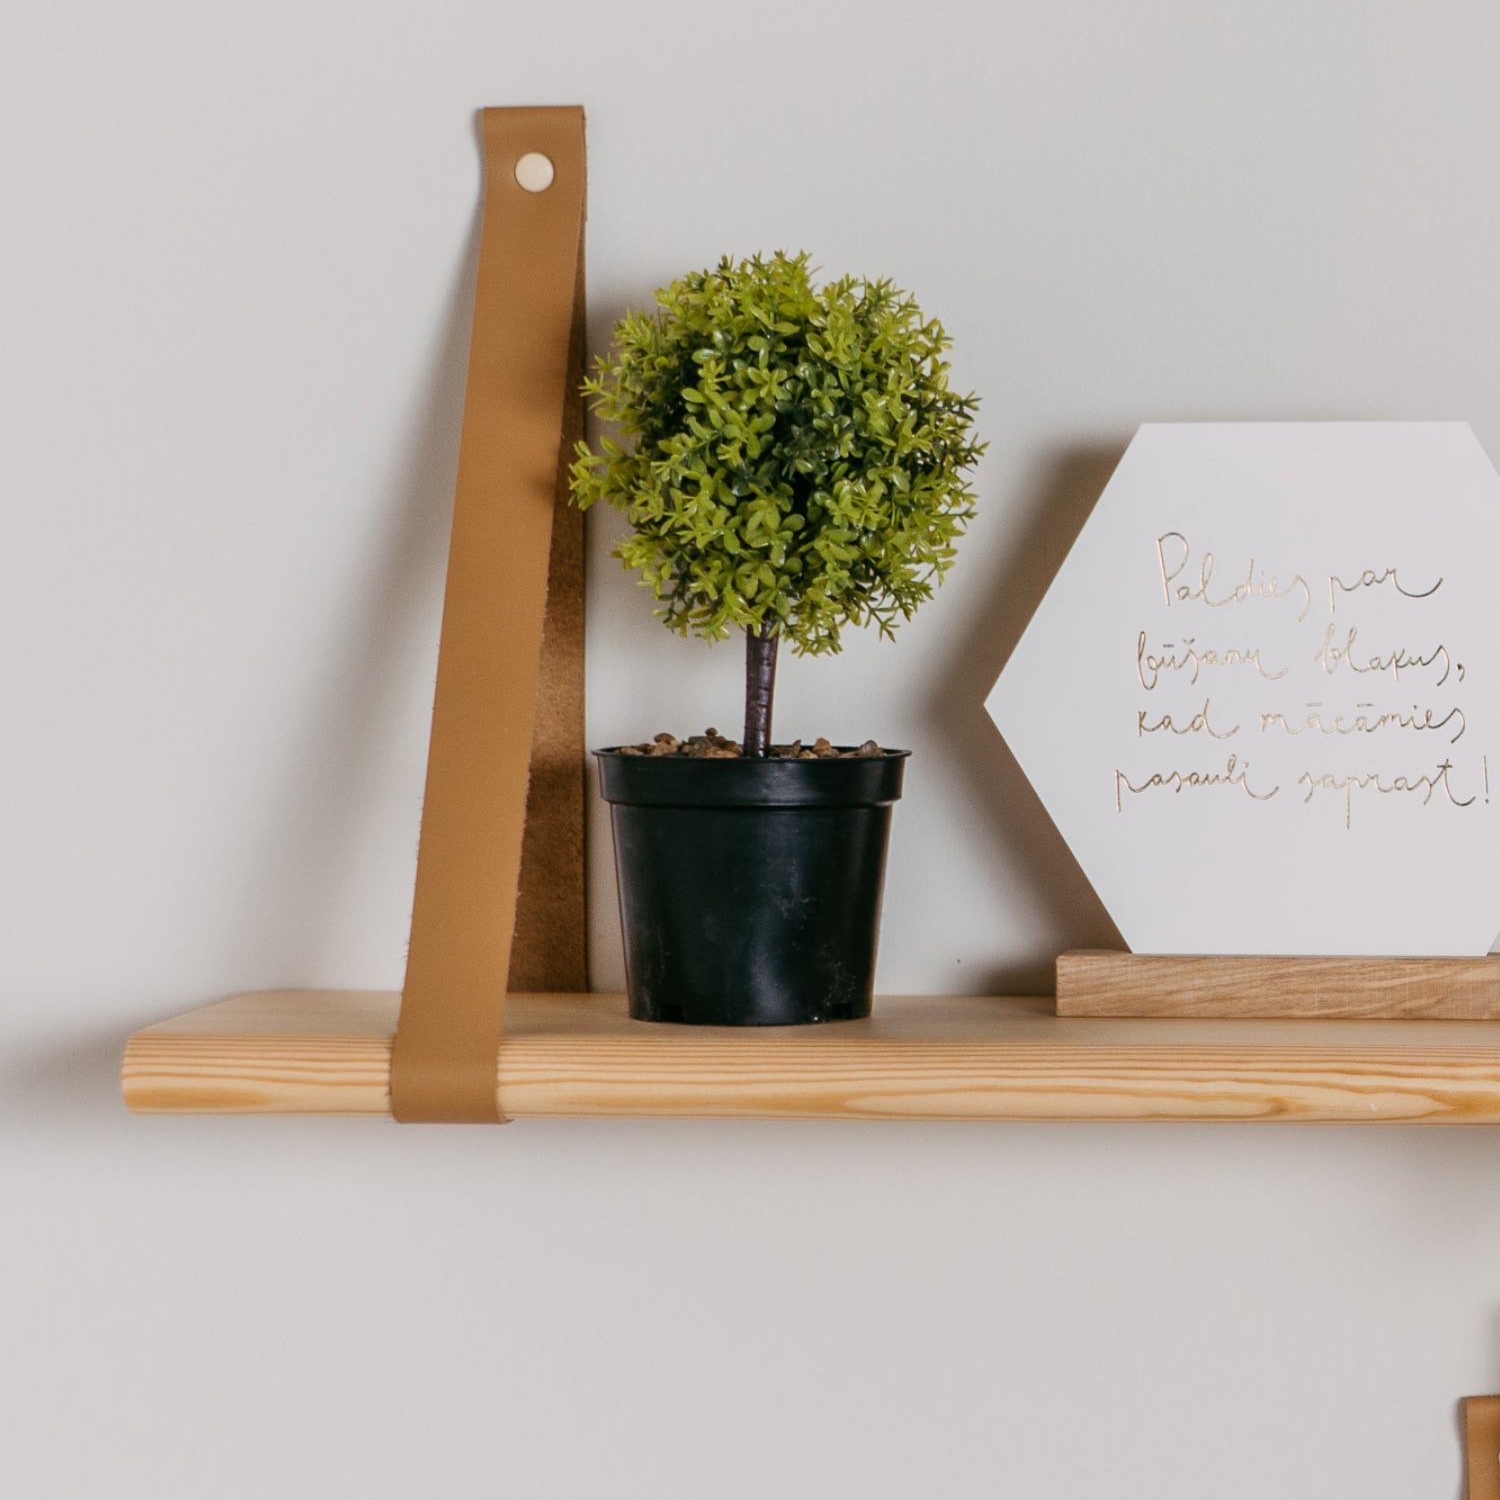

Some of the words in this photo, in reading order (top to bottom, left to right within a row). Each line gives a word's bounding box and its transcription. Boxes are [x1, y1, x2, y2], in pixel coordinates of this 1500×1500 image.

[1156, 532, 1311, 623] Paldies
[1328, 565, 1444, 614] par
[1136, 630, 1290, 691] būšanu
[1313, 622, 1466, 687] blakus,
[1137, 698, 1241, 740] kad
[1259, 702, 1467, 744] mācāmies
[1113, 754, 1280, 812] pasauli
[1297, 755, 1490, 830] saprast!
